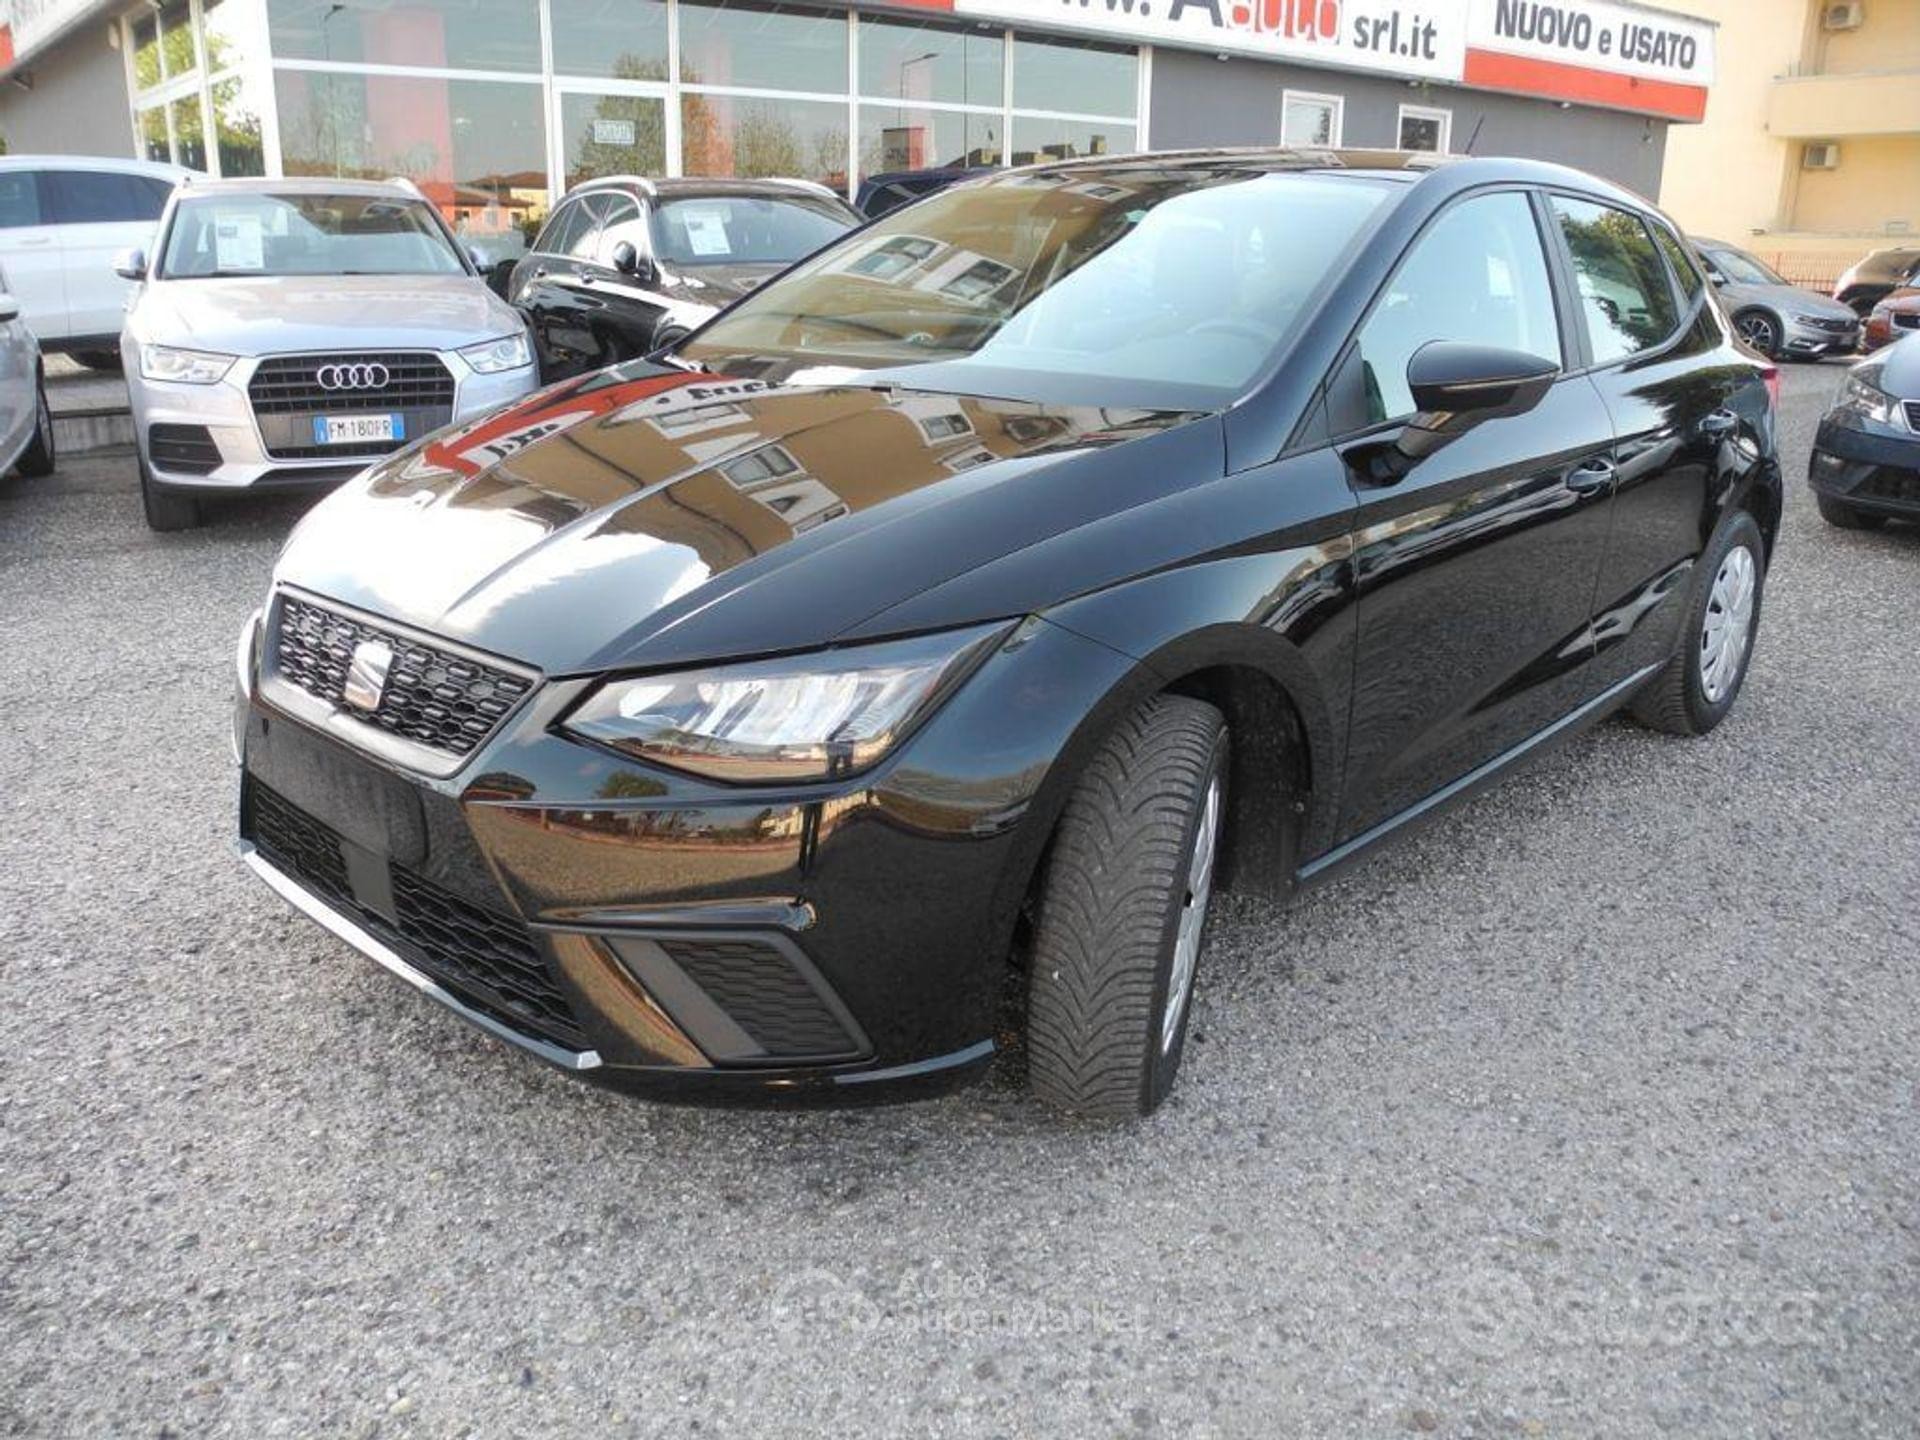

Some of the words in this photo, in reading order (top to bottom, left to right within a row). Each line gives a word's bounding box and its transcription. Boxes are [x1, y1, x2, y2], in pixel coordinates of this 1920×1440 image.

[1353, 10, 1437, 60] srl.it
[1495, 0, 1592, 50] NUOVO
[1599, 29, 1612, 55] e
[1620, 23, 1697, 70] USATO
